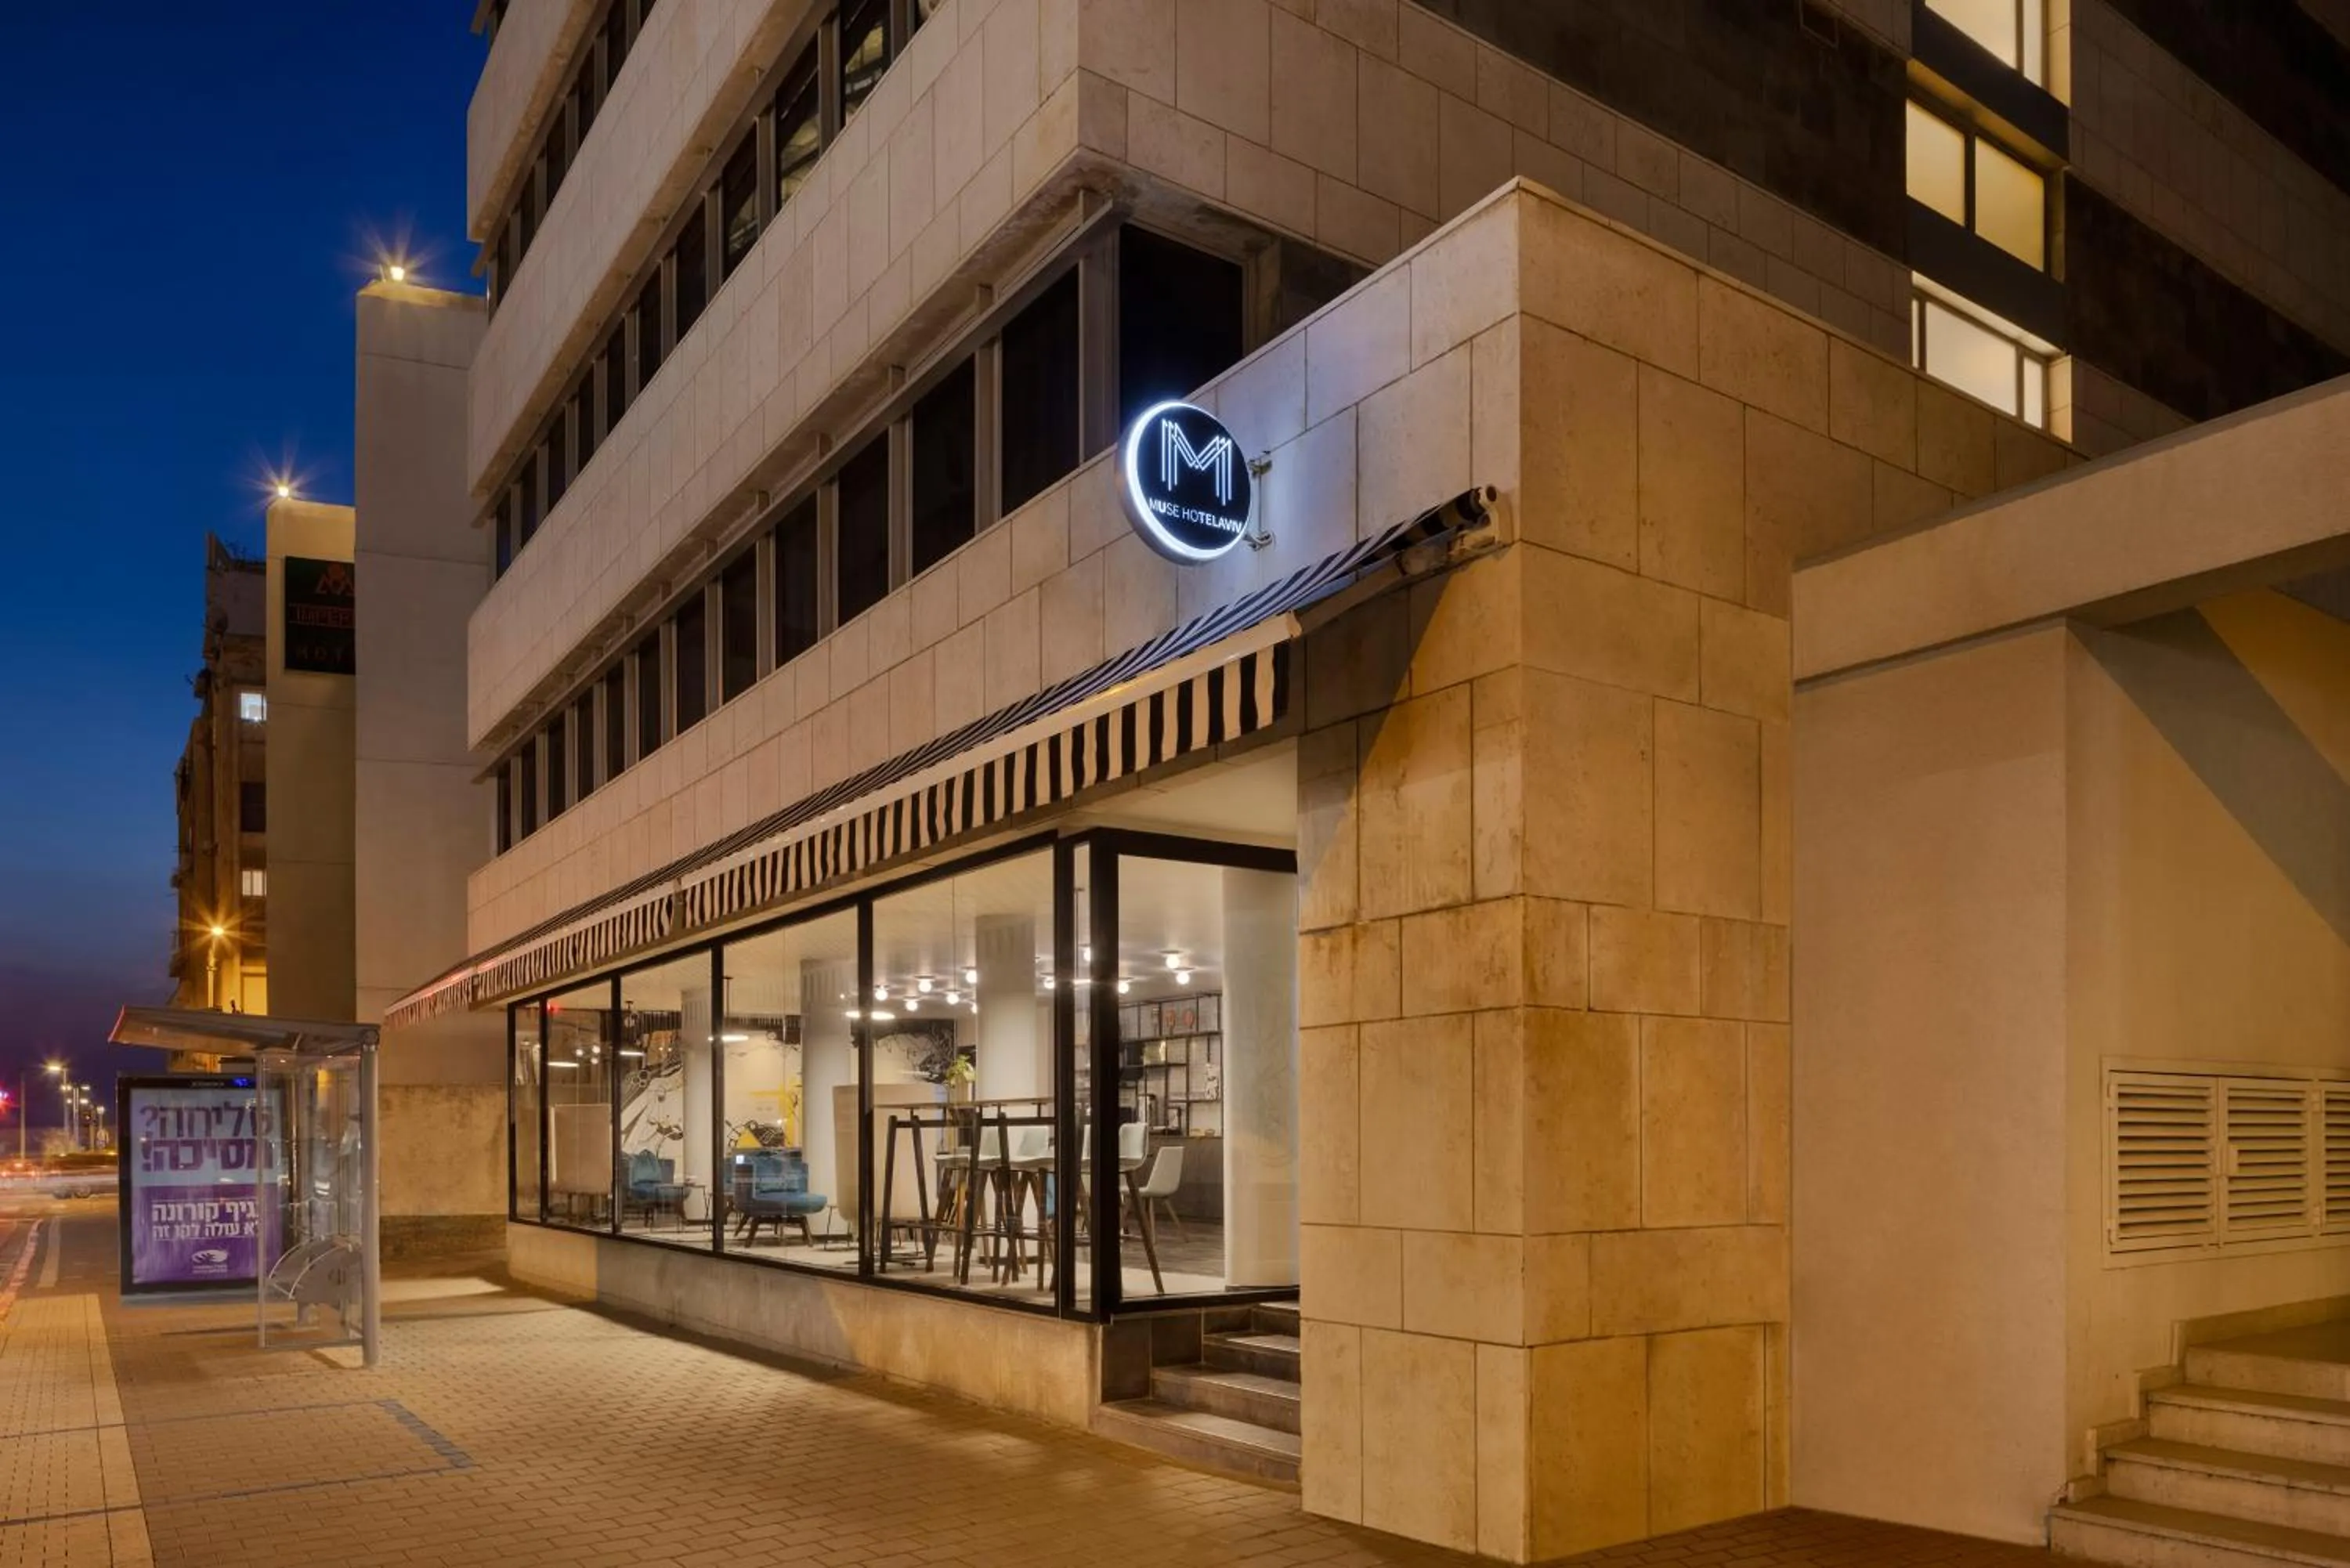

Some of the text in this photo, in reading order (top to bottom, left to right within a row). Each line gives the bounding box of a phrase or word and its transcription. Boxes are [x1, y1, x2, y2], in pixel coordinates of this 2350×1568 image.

[1162, 418, 1232, 506] M
[1148, 497, 1180, 518] MUSE
[152, 1201, 260, 1223] גיף קורונה
[153, 1225, 170, 1239] זה
[204, 1222, 240, 1237] עולה
